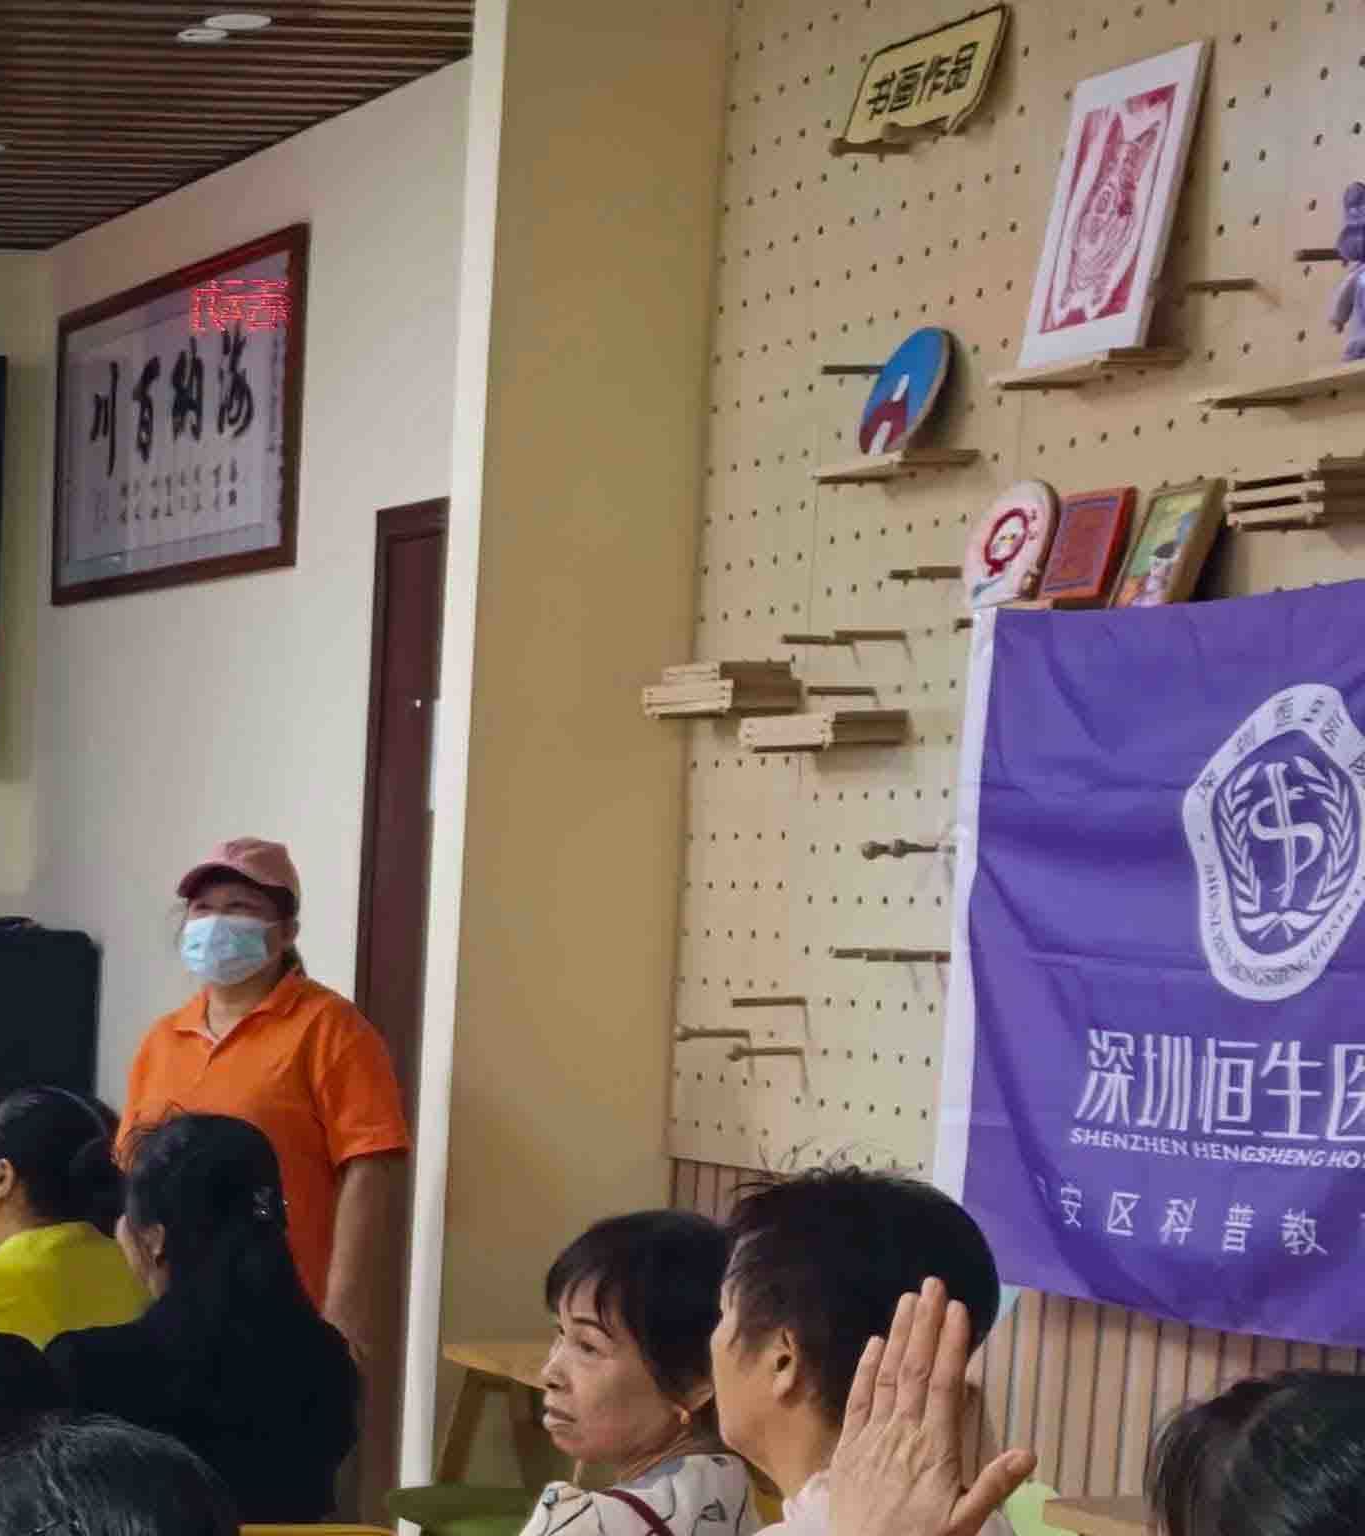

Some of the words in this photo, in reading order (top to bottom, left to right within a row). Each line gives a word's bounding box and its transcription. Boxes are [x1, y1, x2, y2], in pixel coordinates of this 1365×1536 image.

[865, 41, 981, 121] 书画作品
[1074, 1028, 1365, 1142] 深圳恒生医
[1070, 1127, 1188, 1156] SHENZHEN
[1194, 1143, 1327, 1167] HENGSHENG
[1037, 1176, 1365, 1257] 安区科普教
